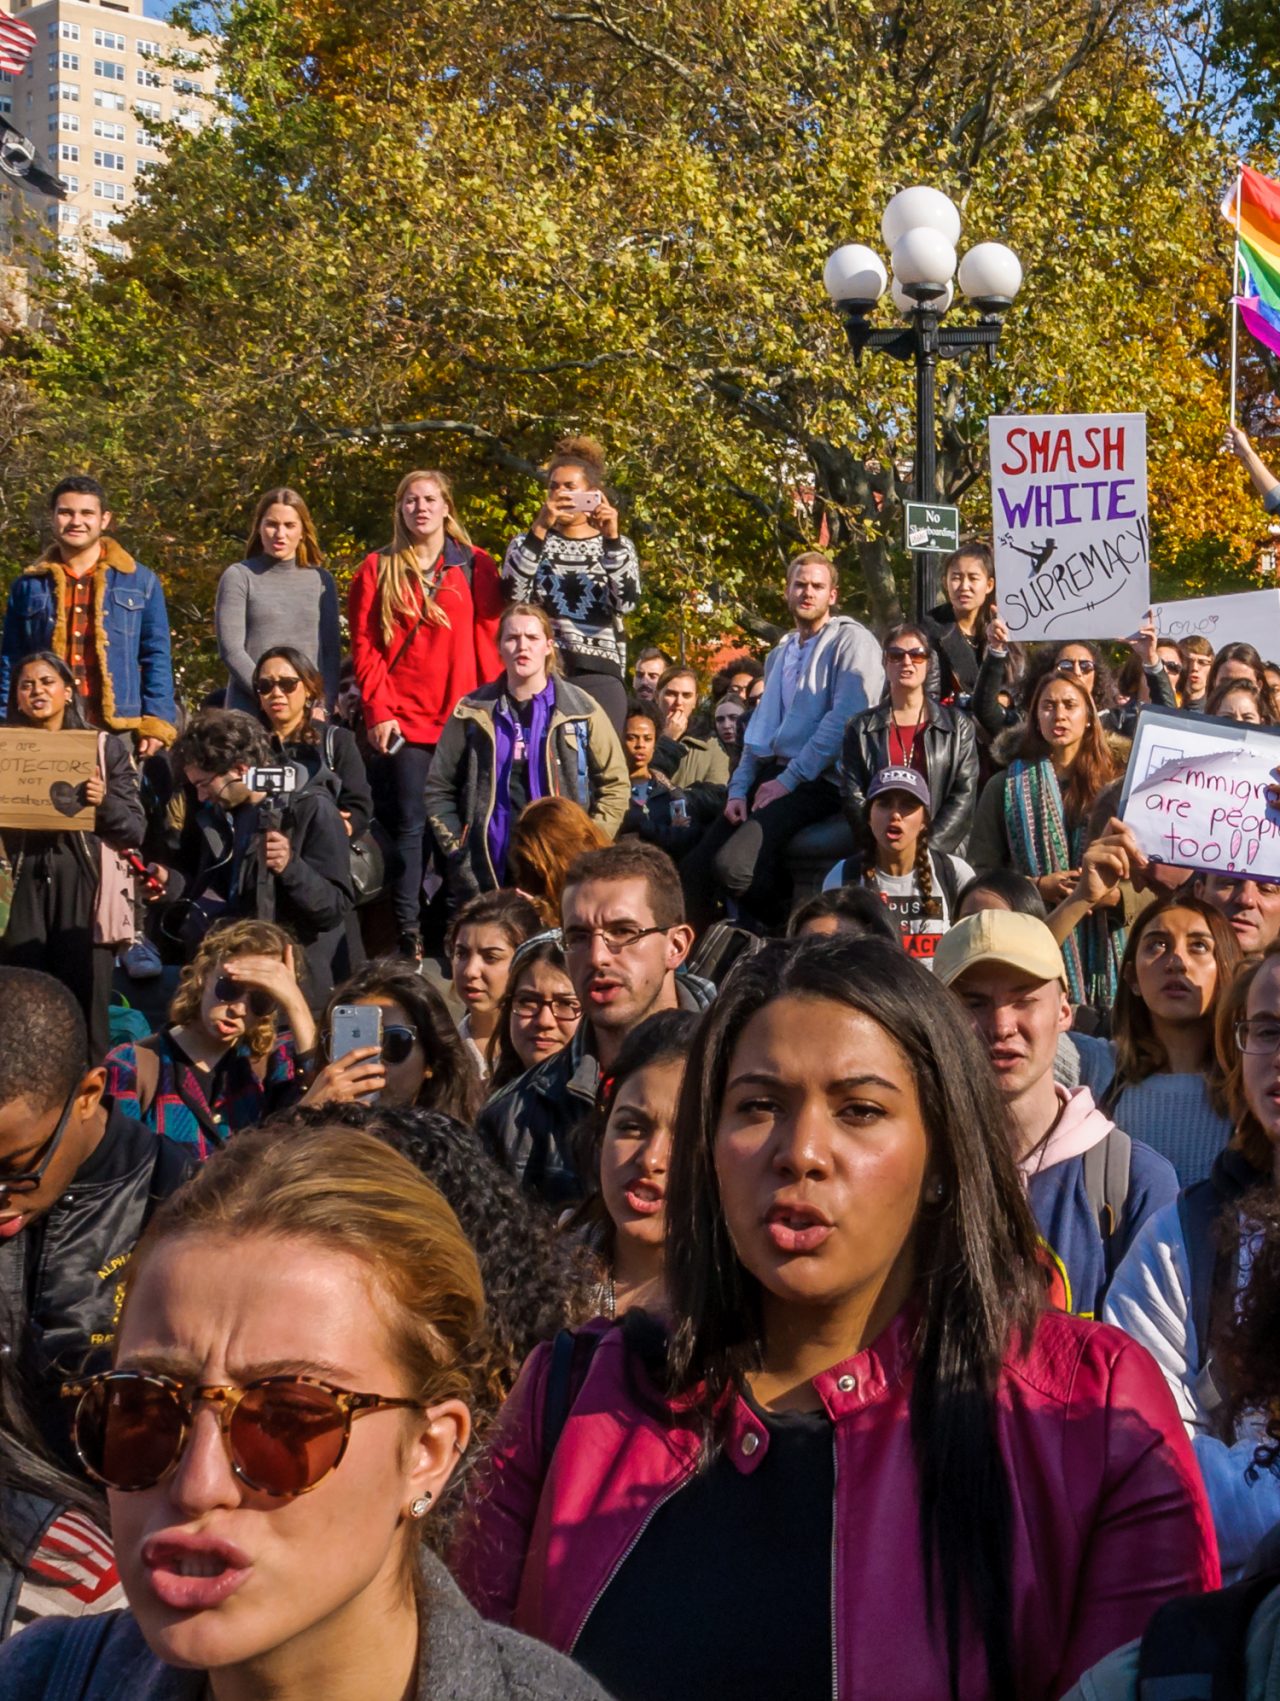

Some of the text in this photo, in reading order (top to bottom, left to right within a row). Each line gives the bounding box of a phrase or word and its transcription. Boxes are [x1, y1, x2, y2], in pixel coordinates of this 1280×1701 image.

[1001, 427, 1126, 476] SMASH
[997, 479, 1137, 529] WHITE
[926, 509, 941, 523] No
[909, 524, 956, 540] Skatboarding
[1154, 606, 1218, 635] Love
[16, 742, 41, 753] are
[0, 758, 93, 775] OTECTORS
[18, 777, 43, 786] NOT
[1145, 794, 1191, 819] are
